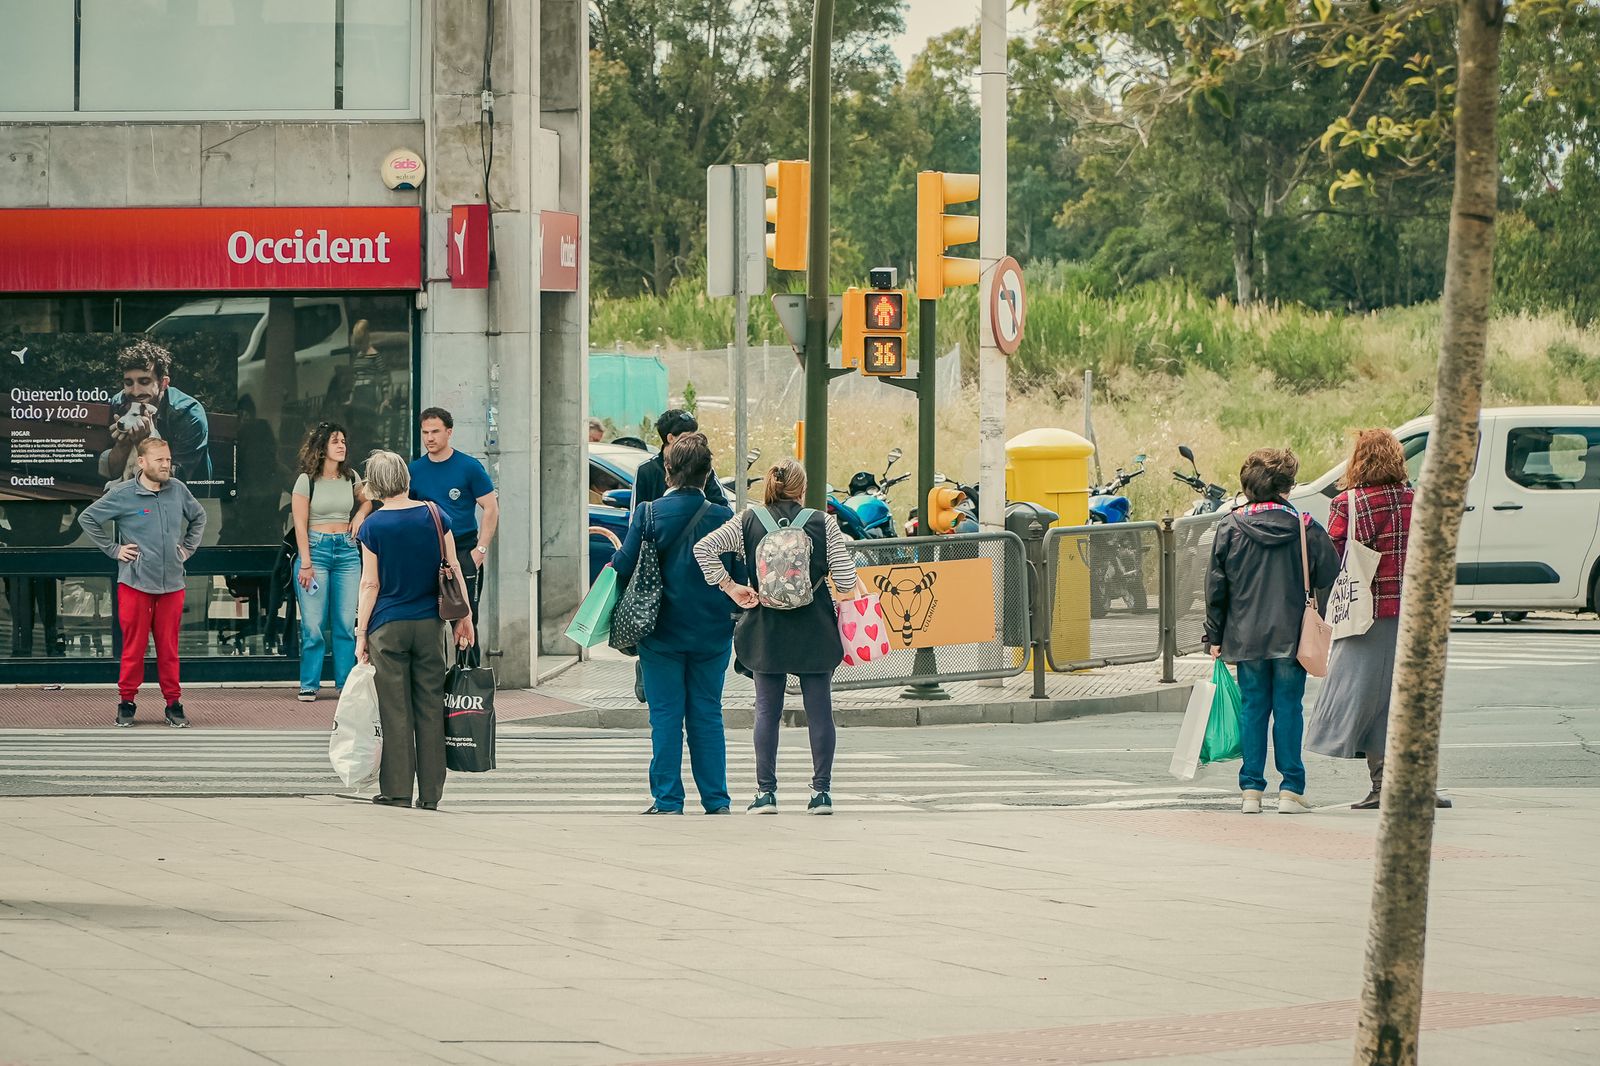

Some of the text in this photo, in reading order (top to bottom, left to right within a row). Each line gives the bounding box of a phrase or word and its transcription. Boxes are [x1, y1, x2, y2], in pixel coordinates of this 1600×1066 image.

[227, 229, 391, 265] Occident
[873, 342, 896, 367] 36
[10, 387, 112, 404] Quererlo todo,
[10, 405, 89, 422] todo y todo
[11, 476, 55, 486] Occident
[922, 599, 939, 633] CULMINA
